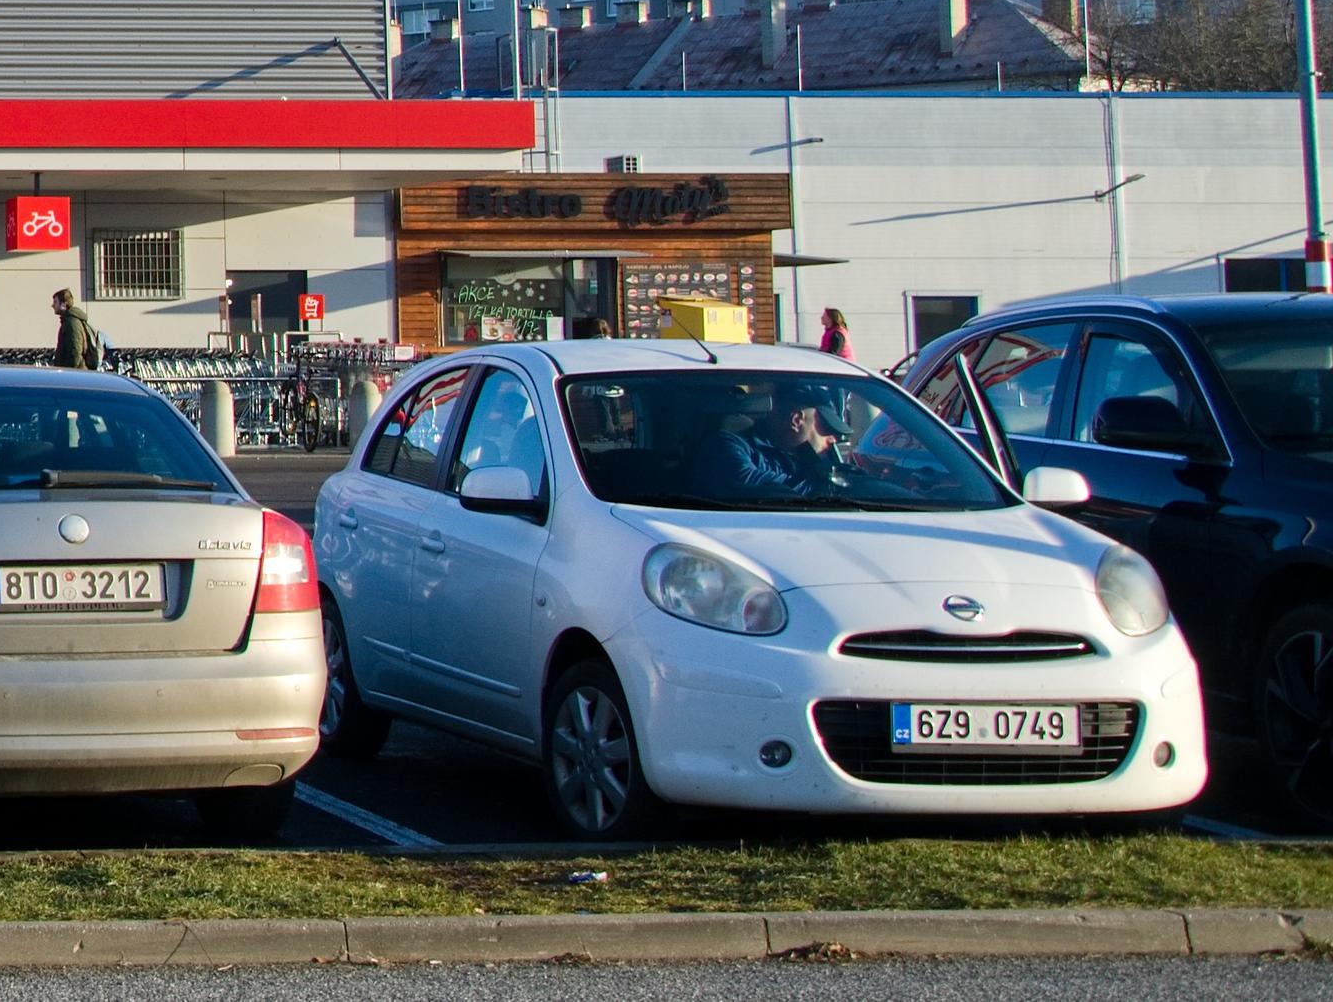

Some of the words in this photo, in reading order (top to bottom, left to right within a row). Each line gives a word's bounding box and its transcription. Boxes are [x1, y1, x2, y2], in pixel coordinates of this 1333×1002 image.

[466, 185, 583, 219] Bistro
[458, 284, 495, 304] AKCE
[81, 569, 151, 599] 3212
[895, 728, 910, 739] CZ
[917, 709, 971, 739] 6Z9
[994, 710, 1065, 740] 0749
